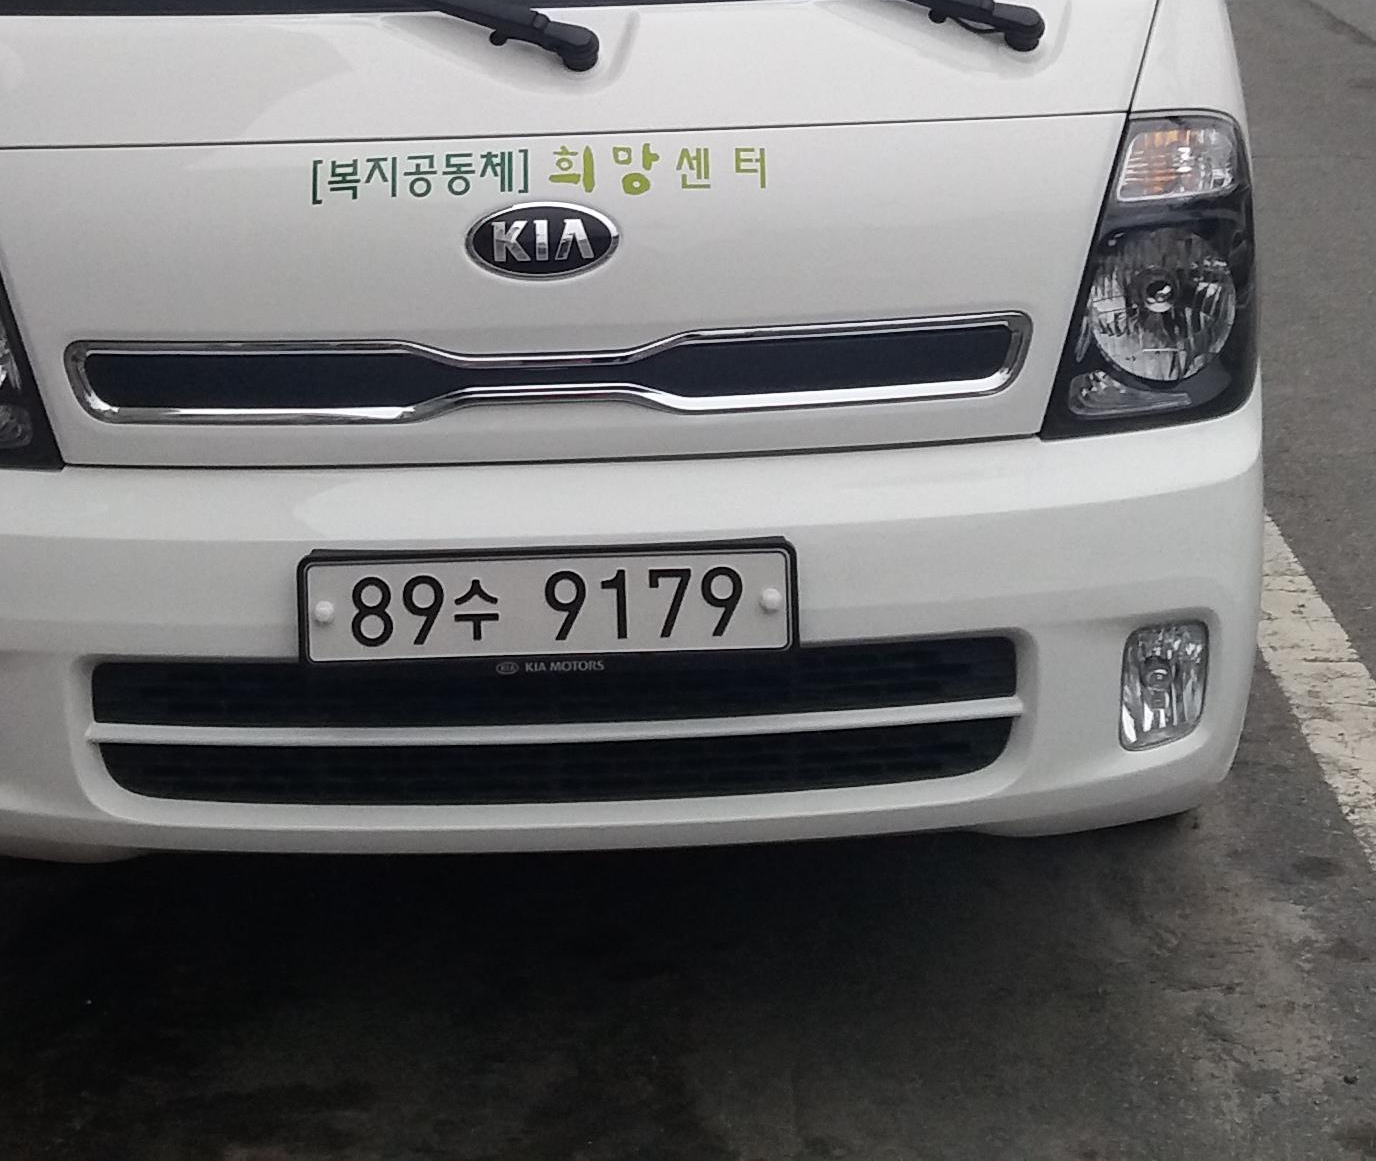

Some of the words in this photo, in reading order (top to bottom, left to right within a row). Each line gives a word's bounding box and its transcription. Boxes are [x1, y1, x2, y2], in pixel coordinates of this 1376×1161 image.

[311, 148, 530, 205] [복지공동체]
[490, 219, 597, 263] KIA
[350, 574, 500, 648] 89수
[542, 565, 744, 641] 9179
[524, 662, 546, 673] KIA
[550, 659, 605, 672] MOTORS
